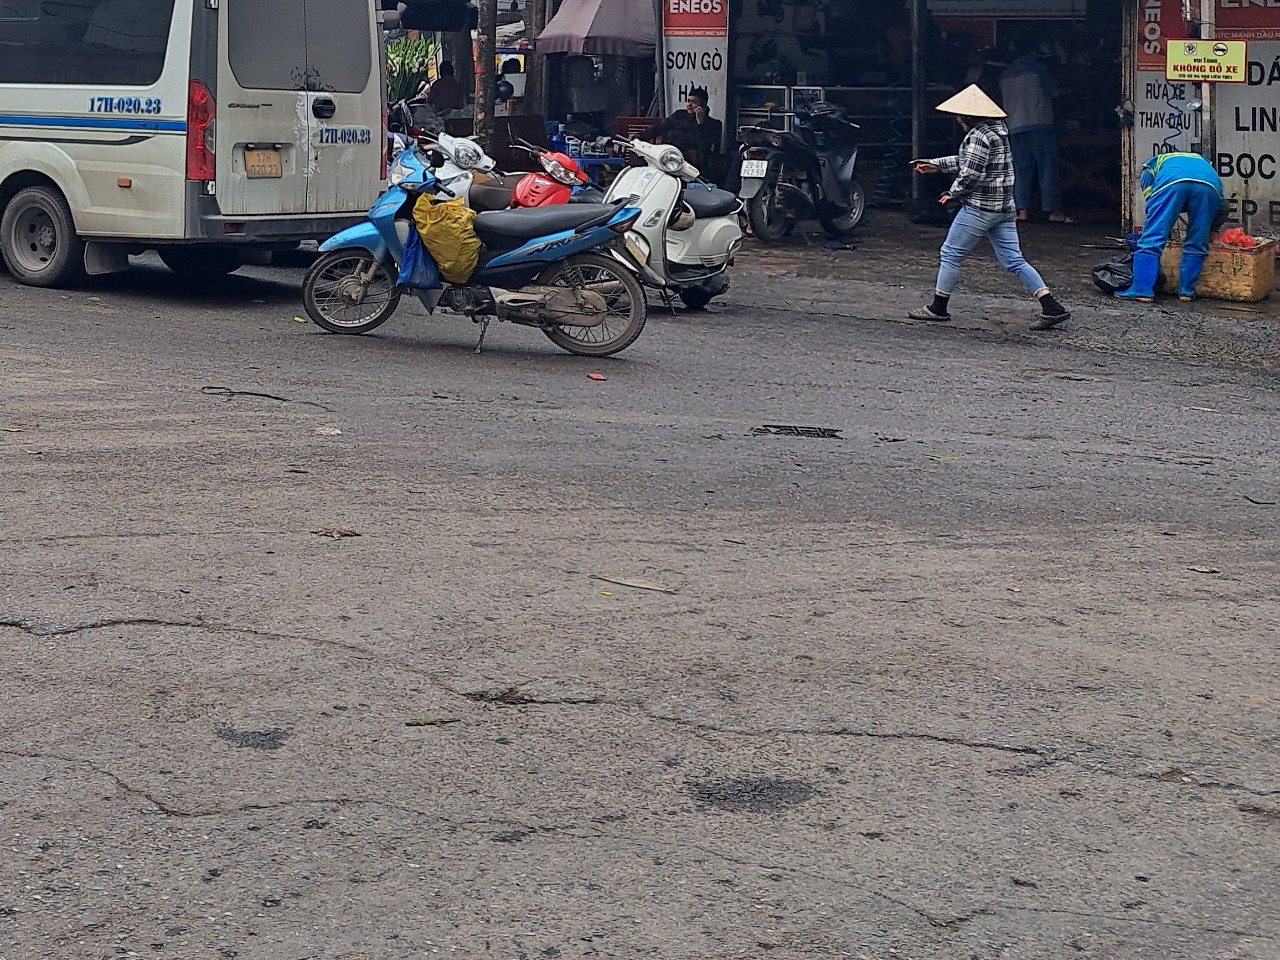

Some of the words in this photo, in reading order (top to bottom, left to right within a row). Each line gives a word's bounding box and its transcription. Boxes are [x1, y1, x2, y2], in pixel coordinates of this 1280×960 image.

[669, 0, 722, 14] ENEOS
[666, 51, 697, 70] SƠN
[701, 47, 723, 71] GÒ
[1173, 64, 1206, 73] KHÔNG
[1225, 66, 1238, 74] XE
[1146, 79, 1169, 100] RỬA
[1173, 83, 1186, 100] XE
[1139, 112, 1166, 129] THAY
[1235, 106, 1280, 132] LIN
